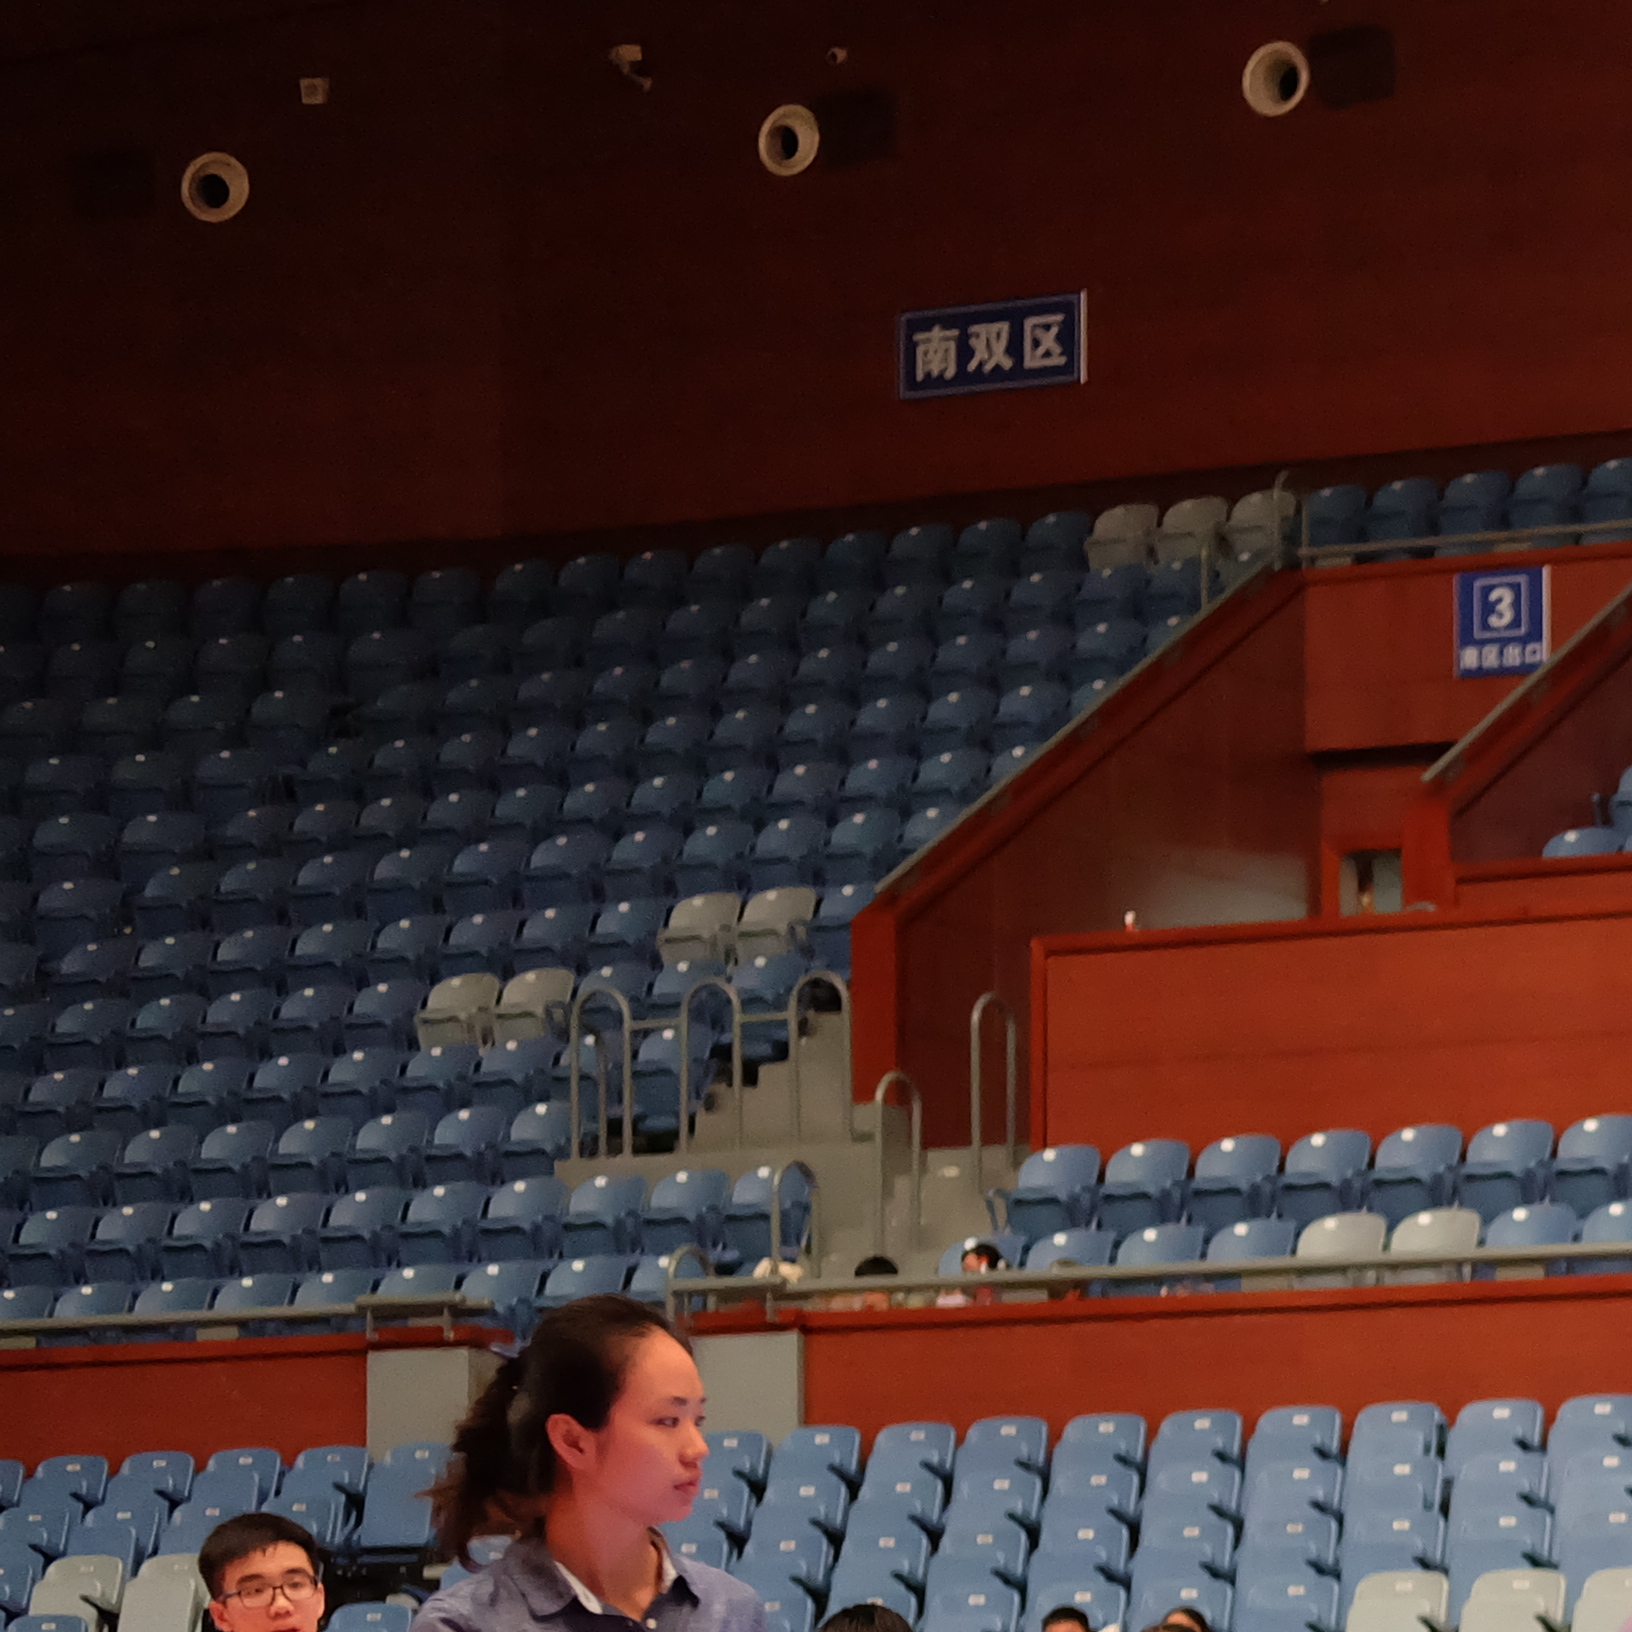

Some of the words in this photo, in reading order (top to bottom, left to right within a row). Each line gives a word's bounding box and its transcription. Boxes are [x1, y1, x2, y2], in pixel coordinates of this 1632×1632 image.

[911, 312, 1068, 383] 南双区
[1487, 585, 1516, 629] 3
